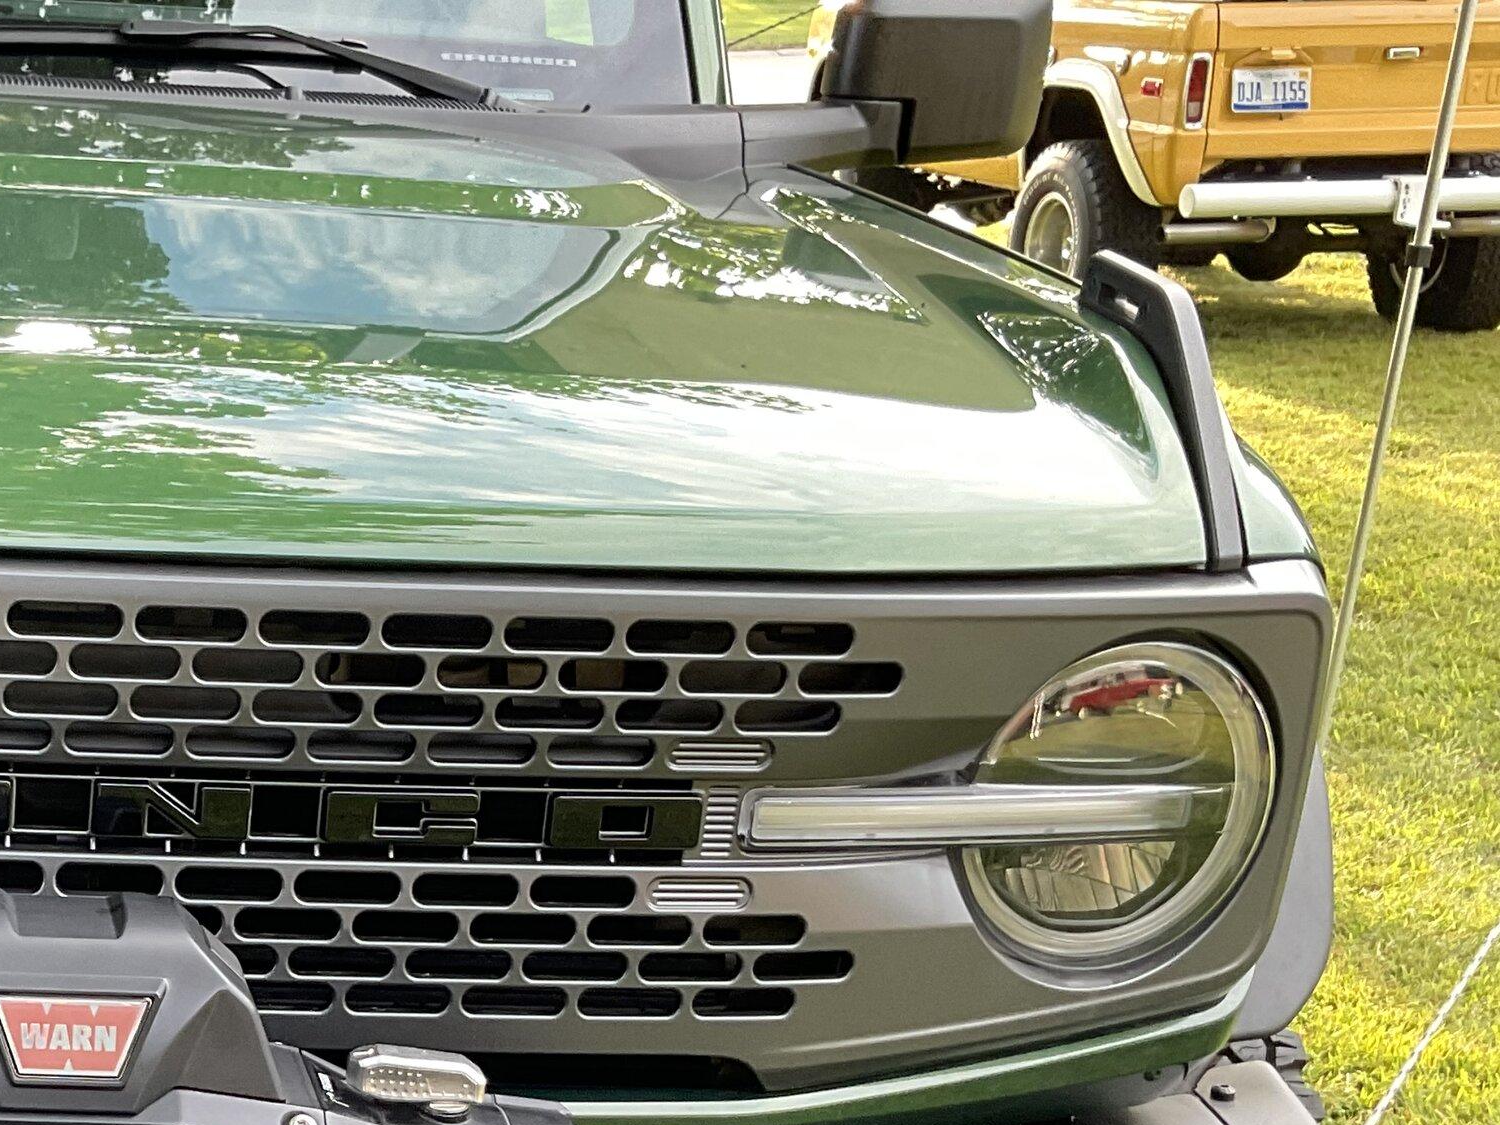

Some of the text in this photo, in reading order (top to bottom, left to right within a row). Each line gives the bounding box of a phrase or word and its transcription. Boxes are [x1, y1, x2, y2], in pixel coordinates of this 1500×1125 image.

[1238, 80, 1307, 102] DJA 1155
[20, 1022, 117, 1052] WARN
